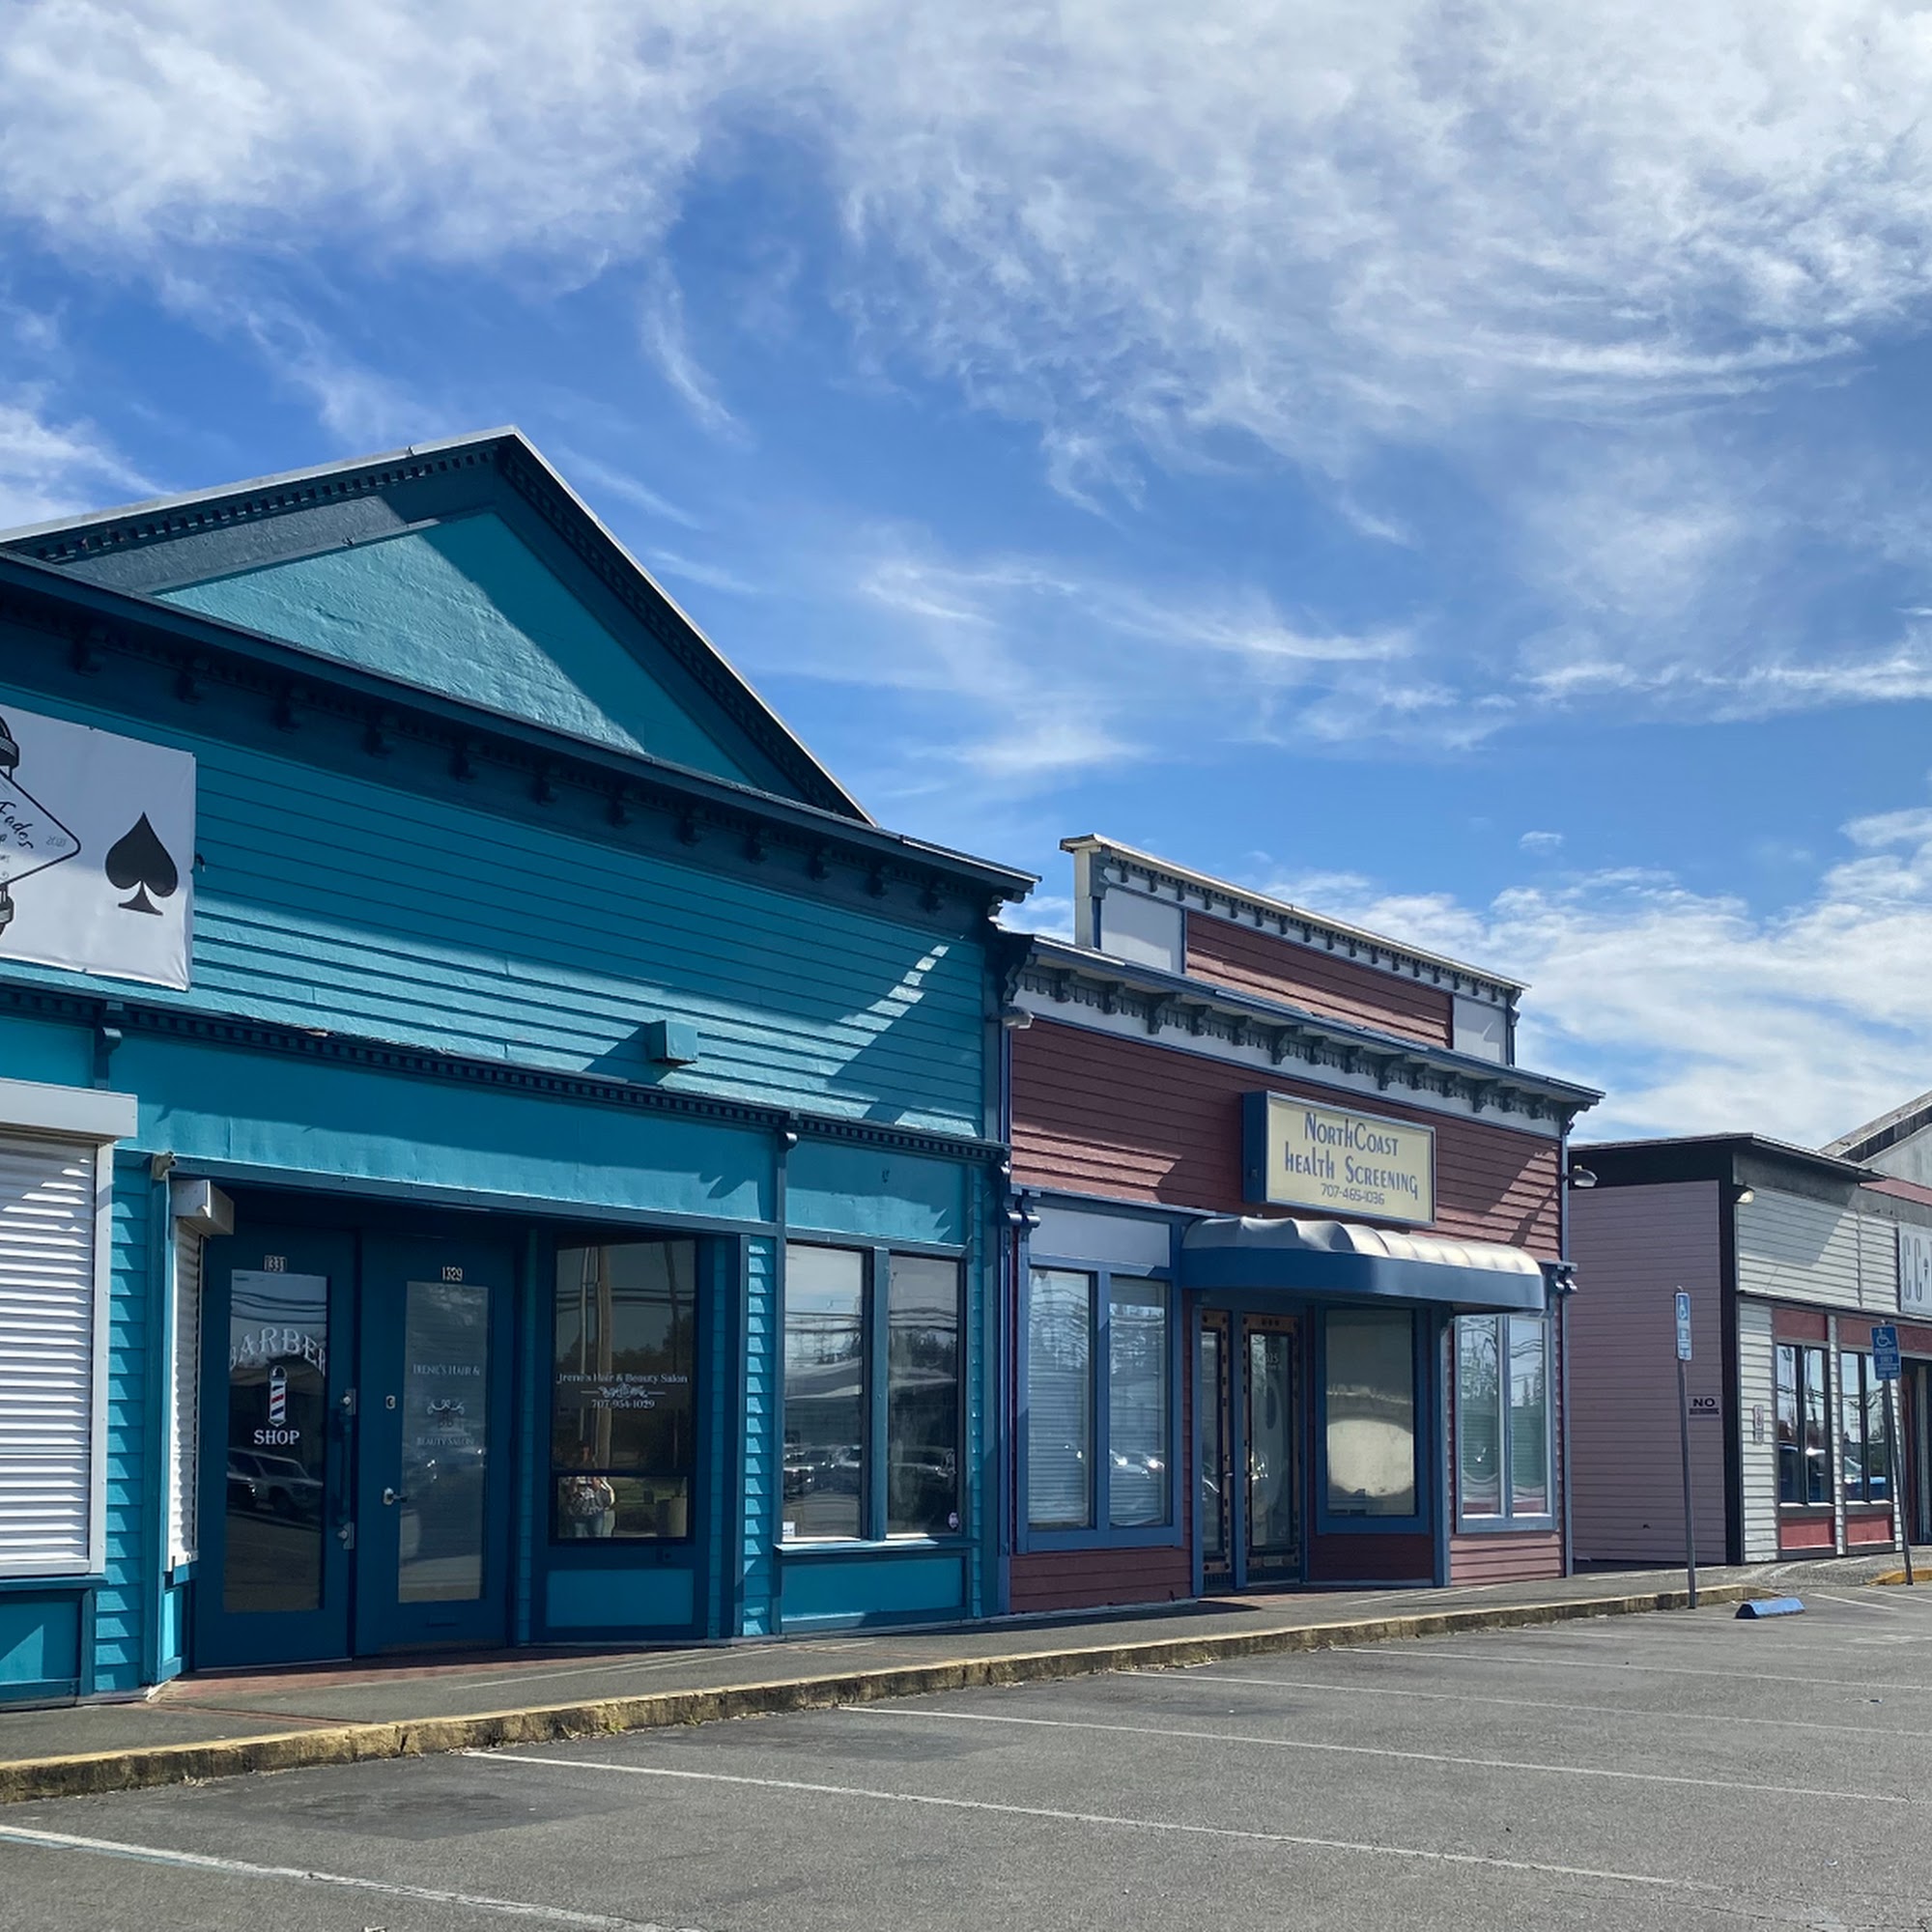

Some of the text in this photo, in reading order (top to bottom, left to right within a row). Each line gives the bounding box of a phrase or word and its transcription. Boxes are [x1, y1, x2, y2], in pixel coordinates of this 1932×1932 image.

[1321, 1183, 1384, 1205] 707-465-1036
[229, 1326, 326, 1377] BARBER
[660, 1374, 689, 1383] Salon
[1692, 1398, 1716, 1407] NO
[253, 1429, 300, 1445] SHOP
